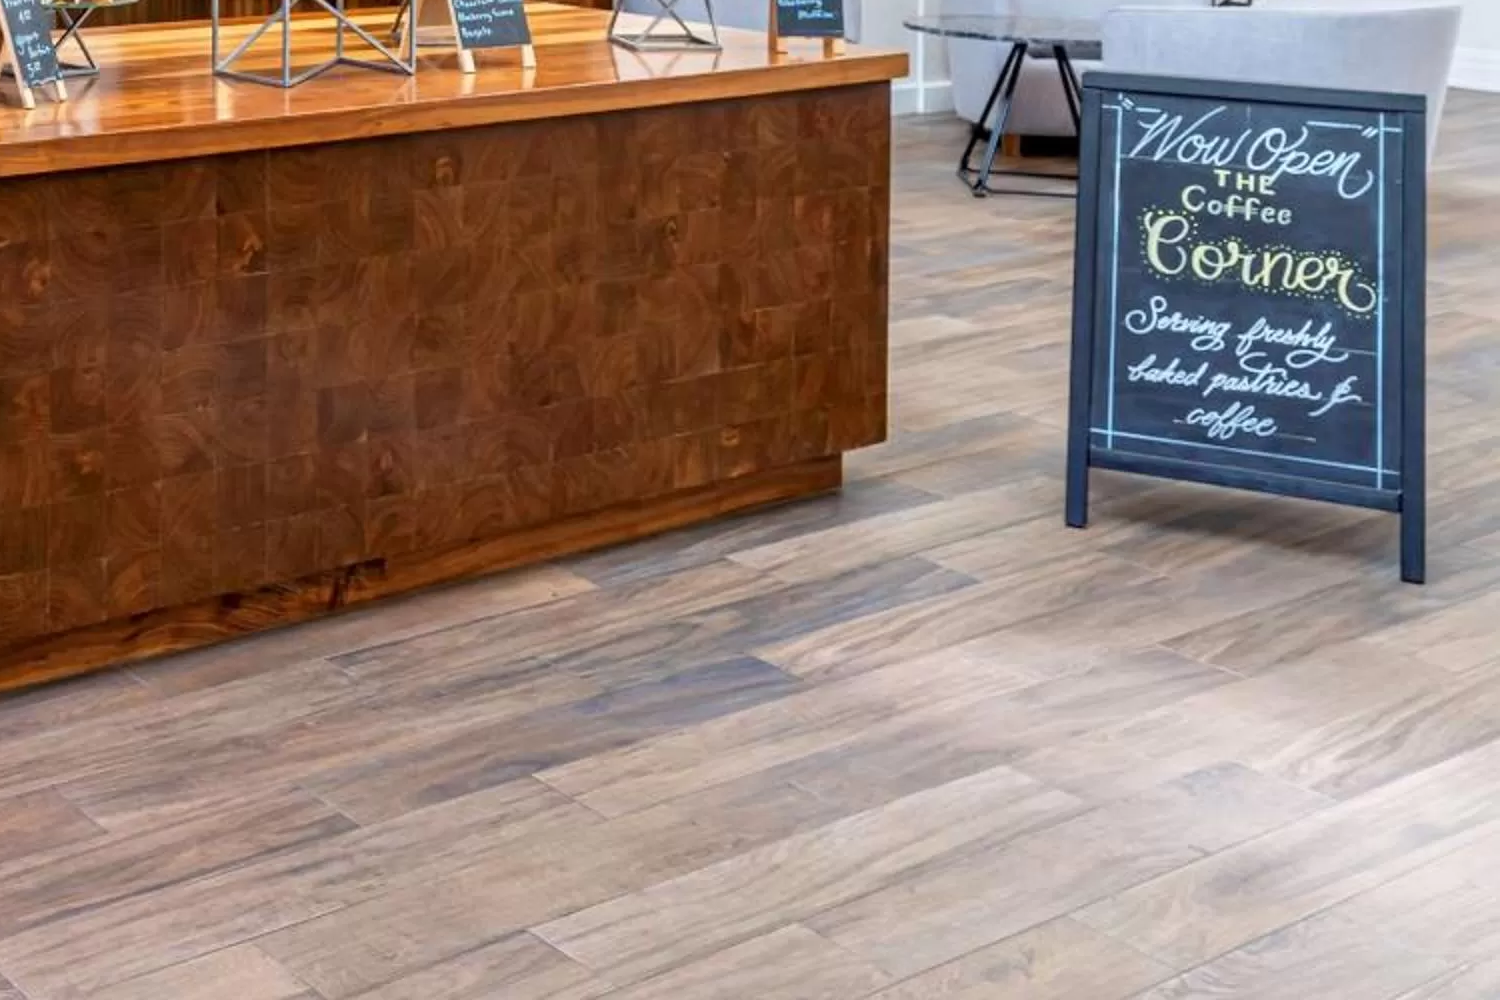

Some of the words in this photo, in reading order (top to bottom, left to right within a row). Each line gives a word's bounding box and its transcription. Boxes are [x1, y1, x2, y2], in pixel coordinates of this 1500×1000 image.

[1213, 168, 1278, 196] THE
[1246, 125, 1375, 199] Open
[1181, 184, 1293, 227] Coffee
[1142, 209, 1378, 314] Corner
[1124, 295, 1233, 352] Serving
[1235, 316, 1349, 368] freshly
[1126, 354, 1202, 390] baked
[1203, 354, 1322, 402] pastries
[1184, 402, 1278, 440] coffee
